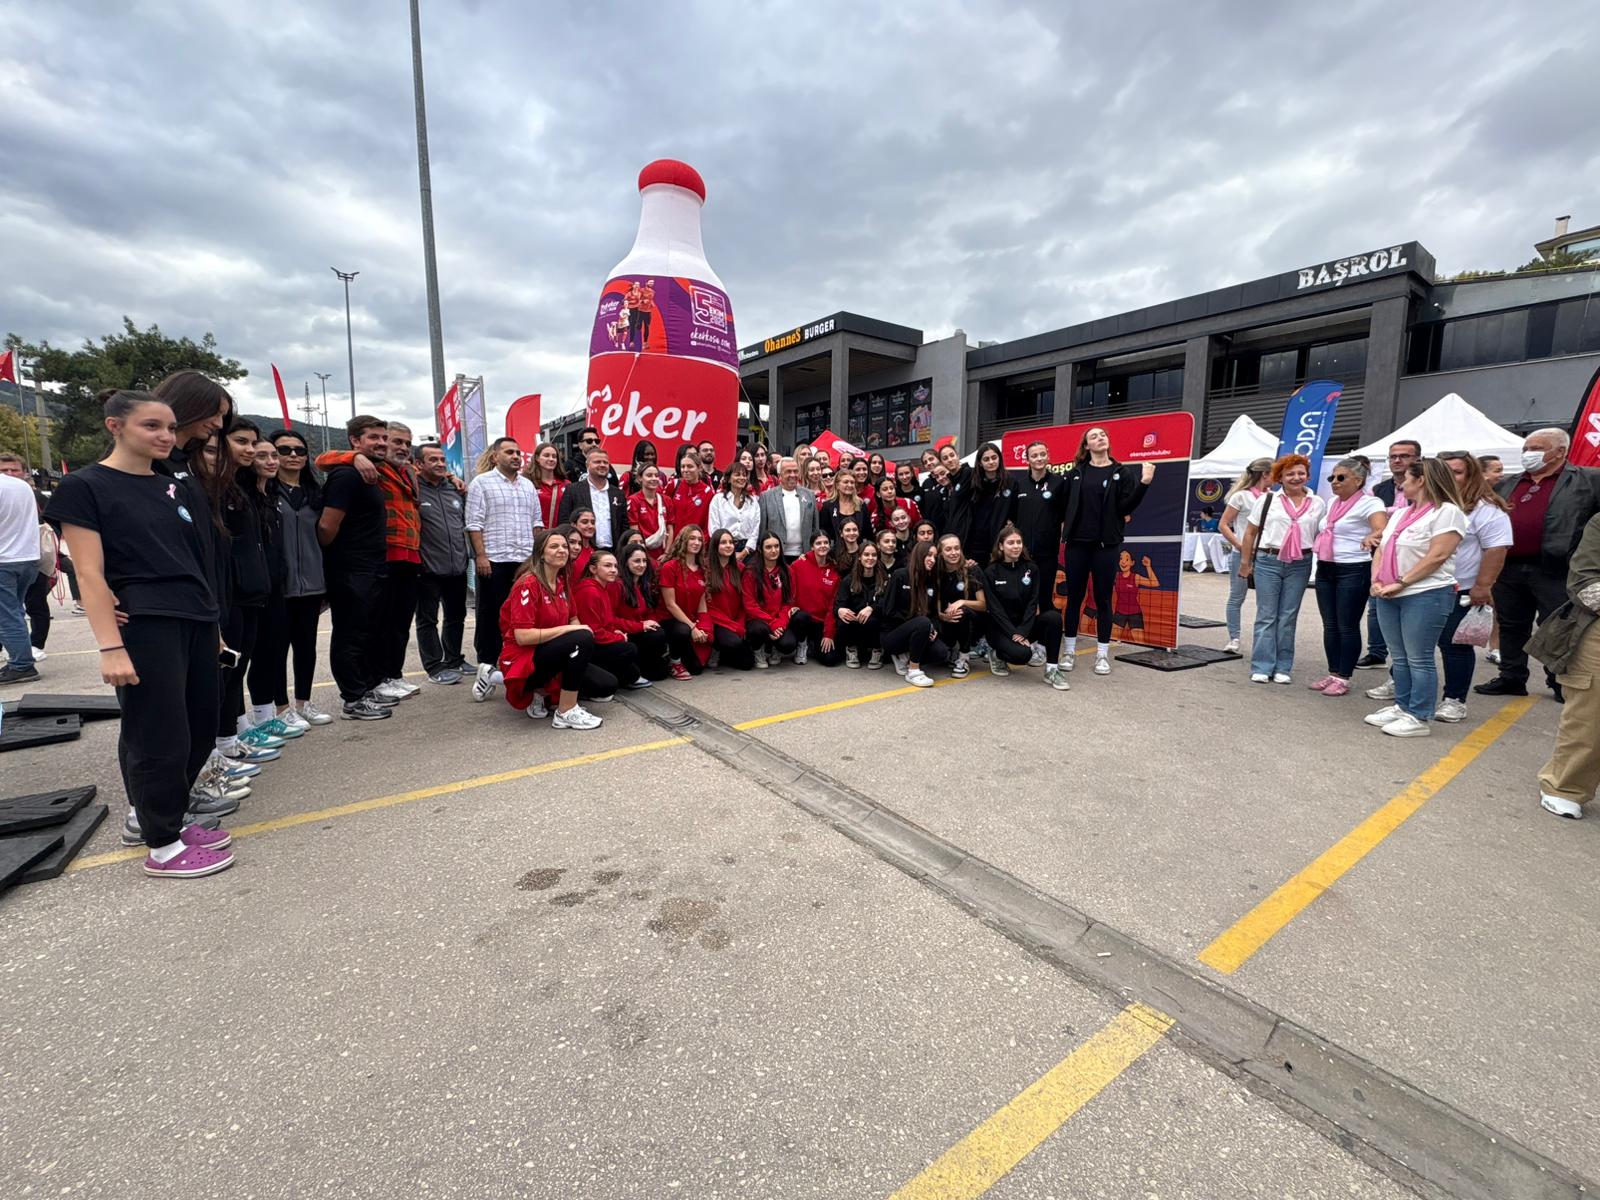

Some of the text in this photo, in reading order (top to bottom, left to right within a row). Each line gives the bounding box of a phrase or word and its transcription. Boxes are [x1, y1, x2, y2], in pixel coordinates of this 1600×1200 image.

[1297, 246, 1407, 289] BAŞROL
[804, 319, 835, 340] BURGER
[601, 391, 707, 441] eker
